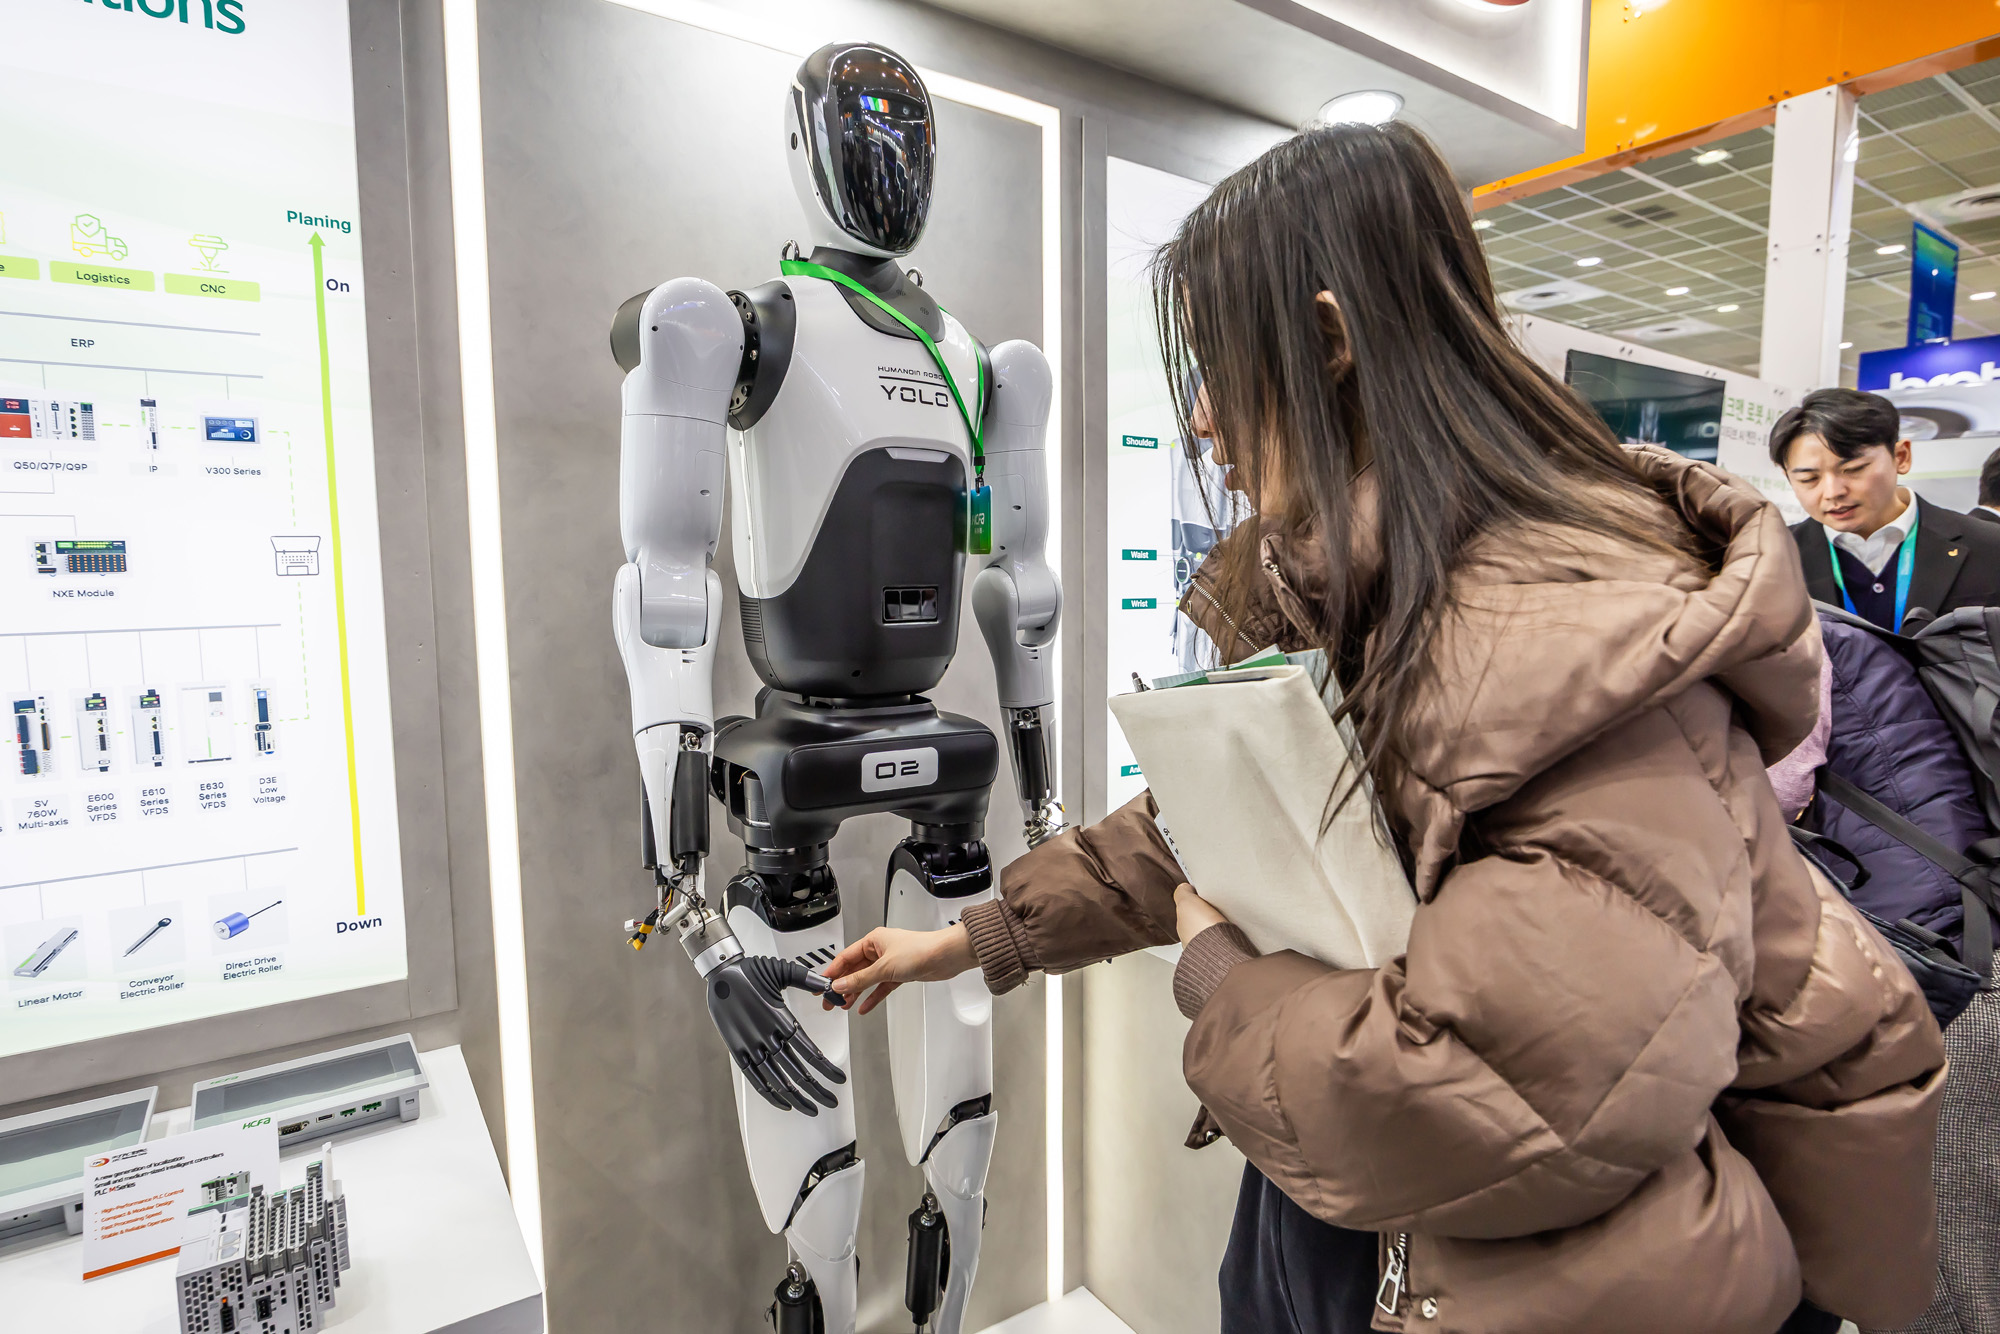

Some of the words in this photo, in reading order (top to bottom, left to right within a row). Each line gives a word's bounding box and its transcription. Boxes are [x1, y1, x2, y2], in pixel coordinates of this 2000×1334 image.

[287, 210, 351, 233] Planing
[76, 270, 130, 285] Logistics
[200, 283, 226, 294] CNC
[326, 278, 350, 293] On
[71, 338, 95, 349] ERP
[880, 384, 949, 407] YOLO
[1125, 437, 1155, 448] Shoulder
[14, 461, 88, 472] Q50/Q7P/Q9P
[205, 467, 231, 475] V300
[233, 467, 261, 476] Series
[1130, 551, 1149, 560] Waist
[53, 590, 75, 598] NXE
[77, 588, 115, 598] Module
[1131, 599, 1148, 608] Wrist
[200, 781, 225, 791] E630
[259, 776, 277, 785] D3E
[142, 787, 166, 797] E610
[199, 790, 227, 800] Series
[260, 785, 278, 794] Low
[34, 799, 49, 808] SV
[87, 793, 114, 803] E600
[140, 796, 169, 807] Series
[253, 794, 286, 805] Voltage
[86, 803, 117, 813] Series
[201, 799, 226, 810] VFDS
[27, 808, 58, 819] 760W
[142, 806, 169, 816] VFDS
[89, 812, 117, 822] VFDS
[18, 818, 69, 830] Multi-axis
[336, 917, 382, 934] Down
[225, 958, 251, 971] Direct
[253, 954, 278, 967] Drive
[223, 967, 257, 981] Electric
[258, 962, 283, 976] Roller
[129, 973, 175, 989] Conveyor
[120, 985, 157, 1000] Electric
[157, 980, 185, 994] Roller
[18, 996, 51, 1009] Linear
[53, 989, 84, 1003] Motor
[94, 1181, 112, 1189] Small
[112, 1177, 124, 1185] and
[124, 1166, 165, 1180] medium-sized
[166, 1159, 194, 1171] intelligent
[195, 1152, 225, 1163] controllers
[114, 1166, 145, 1178] generation
[154, 1156, 185, 1167] localization
[94, 1188, 108, 1197] PLC
[101, 1196, 152, 1214] High-Performance
[152, 1193, 163, 1201] PLC
[164, 1188, 185, 1197] Control
[101, 1212, 127, 1223] Compact
[132, 1204, 155, 1214] Modular
[156, 1199, 175, 1209] Design
[101, 1224, 113, 1232] Fast
[113, 1216, 145, 1229] Processing
[145, 1211, 162, 1220] Speed
[147, 1216, 175, 1227] Operation
